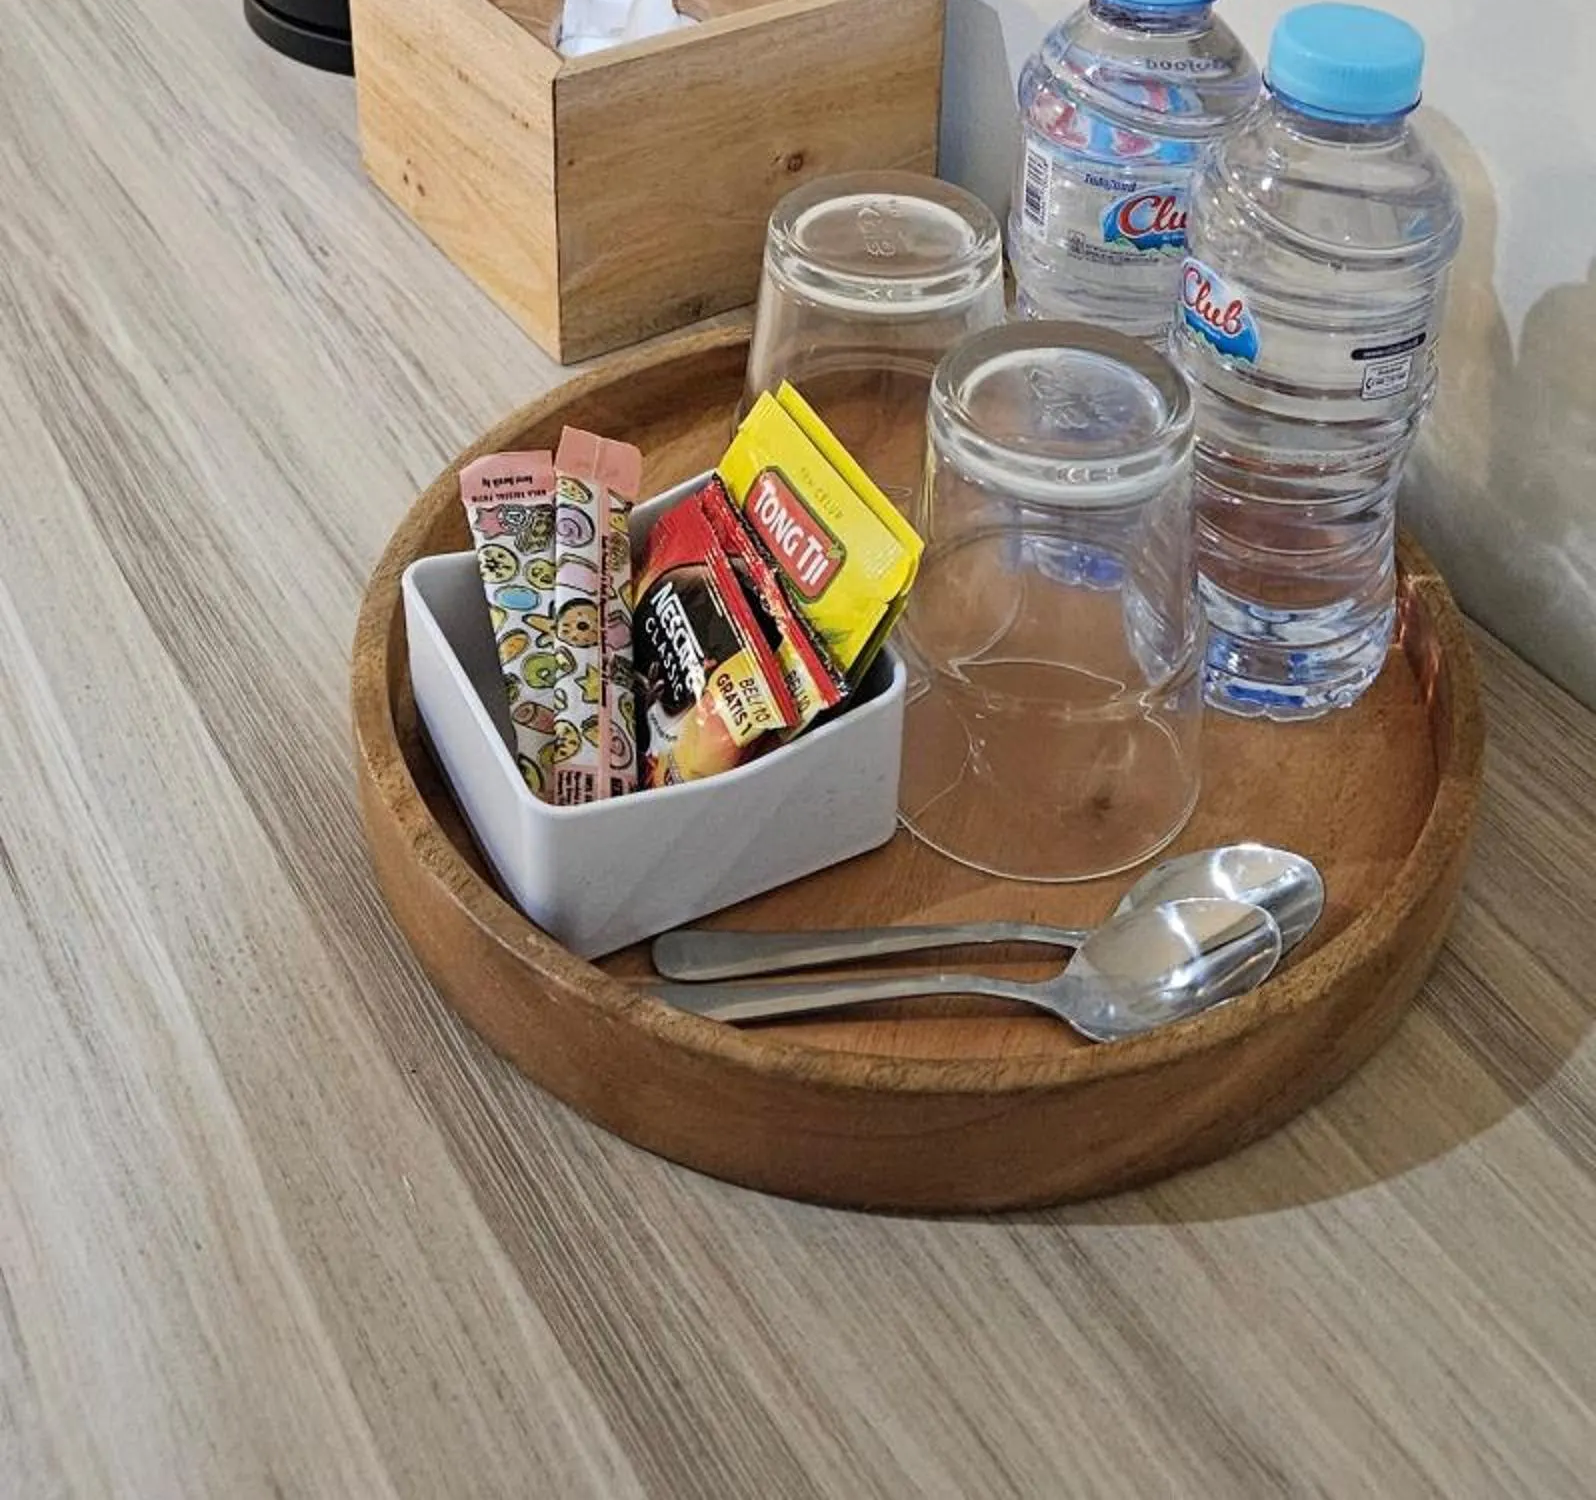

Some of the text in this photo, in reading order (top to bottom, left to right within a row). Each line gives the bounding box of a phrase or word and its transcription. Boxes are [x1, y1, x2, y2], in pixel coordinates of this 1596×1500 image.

[1118, 194, 1188, 237] Clu
[1183, 266, 1244, 335] Club
[753, 478, 830, 587] TONG TJI
[645, 616, 684, 702] CLASSIC
[738, 677, 764, 706] BELI
[716, 672, 753, 737] GRATIS 1
